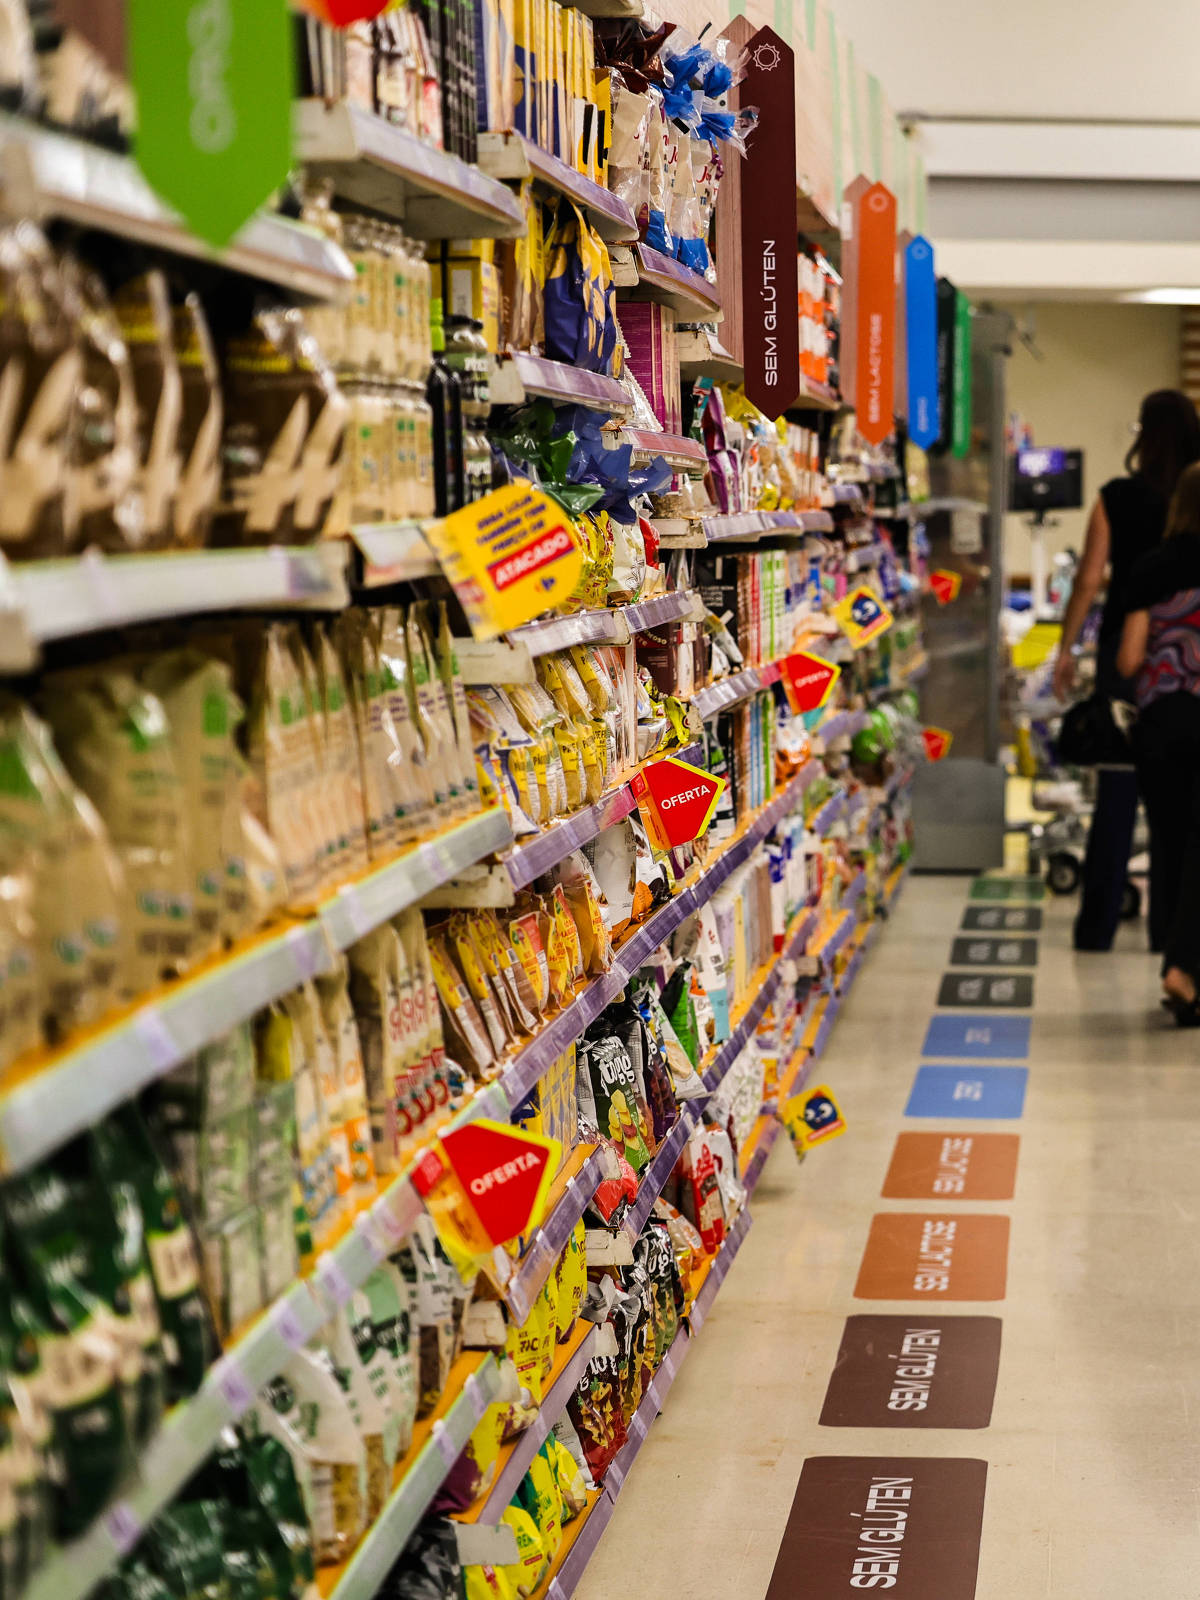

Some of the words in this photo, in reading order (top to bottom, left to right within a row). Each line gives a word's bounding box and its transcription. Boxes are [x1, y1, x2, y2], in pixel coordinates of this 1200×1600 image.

[760, 240, 777, 331] GLÚTEN
[765, 337, 778, 386] SEM
[869, 313, 882, 387] LACTOSE
[868, 388, 881, 424] SEM
[495, 530, 571, 586] ATACADO
[795, 670, 831, 689] OFERTA
[660, 784, 712, 811] OFERTA
[470, 1151, 542, 1196] OFERTA
[913, 1268, 950, 1292] SEM
[888, 1328, 941, 1378] GLÚTEN
[887, 1380, 930, 1412] SEM
[849, 1476, 914, 1544] GLÚTEN
[849, 1546, 902, 1589] SEM
